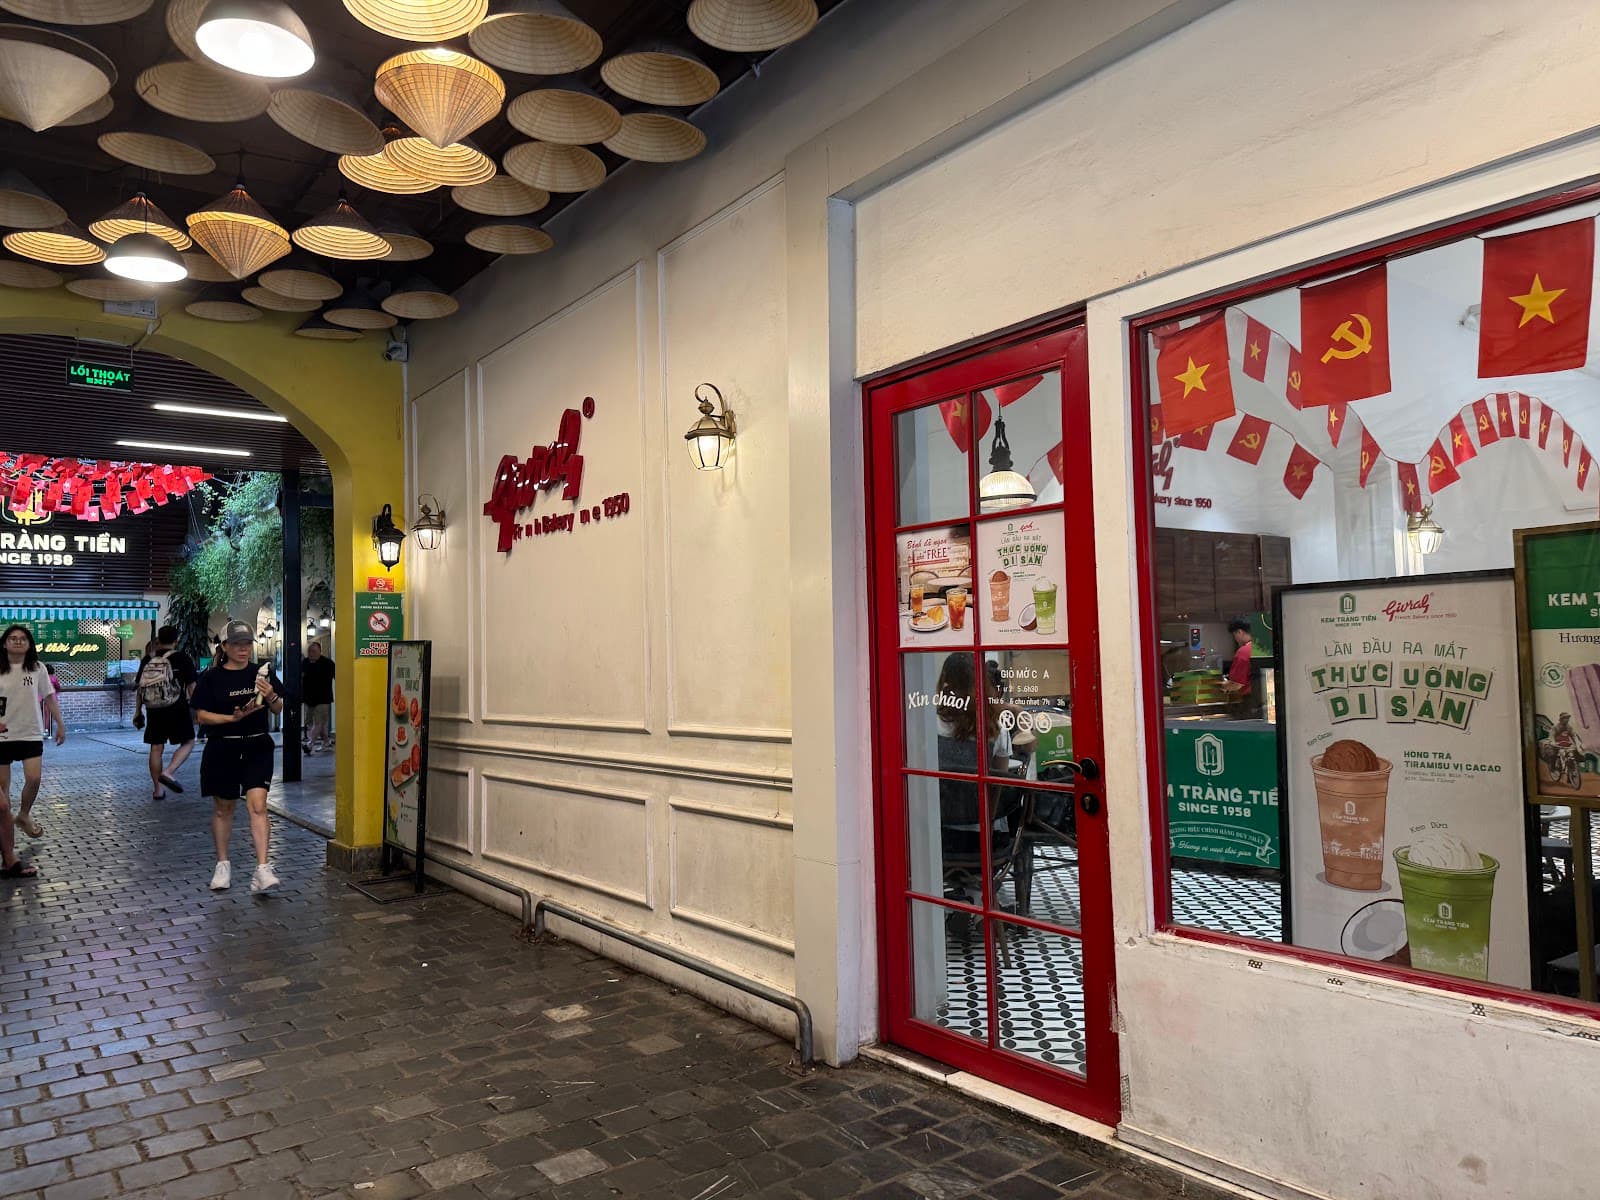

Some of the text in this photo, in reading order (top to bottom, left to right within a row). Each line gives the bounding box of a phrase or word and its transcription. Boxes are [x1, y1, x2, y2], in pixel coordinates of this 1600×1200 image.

[71, 364, 130, 382] LỐI THOÁT
[86, 377, 114, 386] EXIT
[1174, 496, 1193, 507] since
[1194, 497, 1212, 508] 1950
[74, 532, 126, 553] TIỀN
[37, 553, 73, 566] 1958
[1382, 593, 1430, 622] Givral
[1548, 593, 1588, 607] KEM
[1324, 637, 1468, 660] LẦN ĐẦU RA MẮT
[1312, 663, 1487, 692] THỨC UỐNG
[908, 690, 971, 711] Xin chào!
[1330, 692, 1467, 725] DI SẢN
[1404, 760, 1450, 770] TIRAMISU
[1466, 764, 1502, 772] CACAO
[1180, 782, 1242, 804] TRÀNG
[1178, 802, 1252, 818] SINCE 1958
